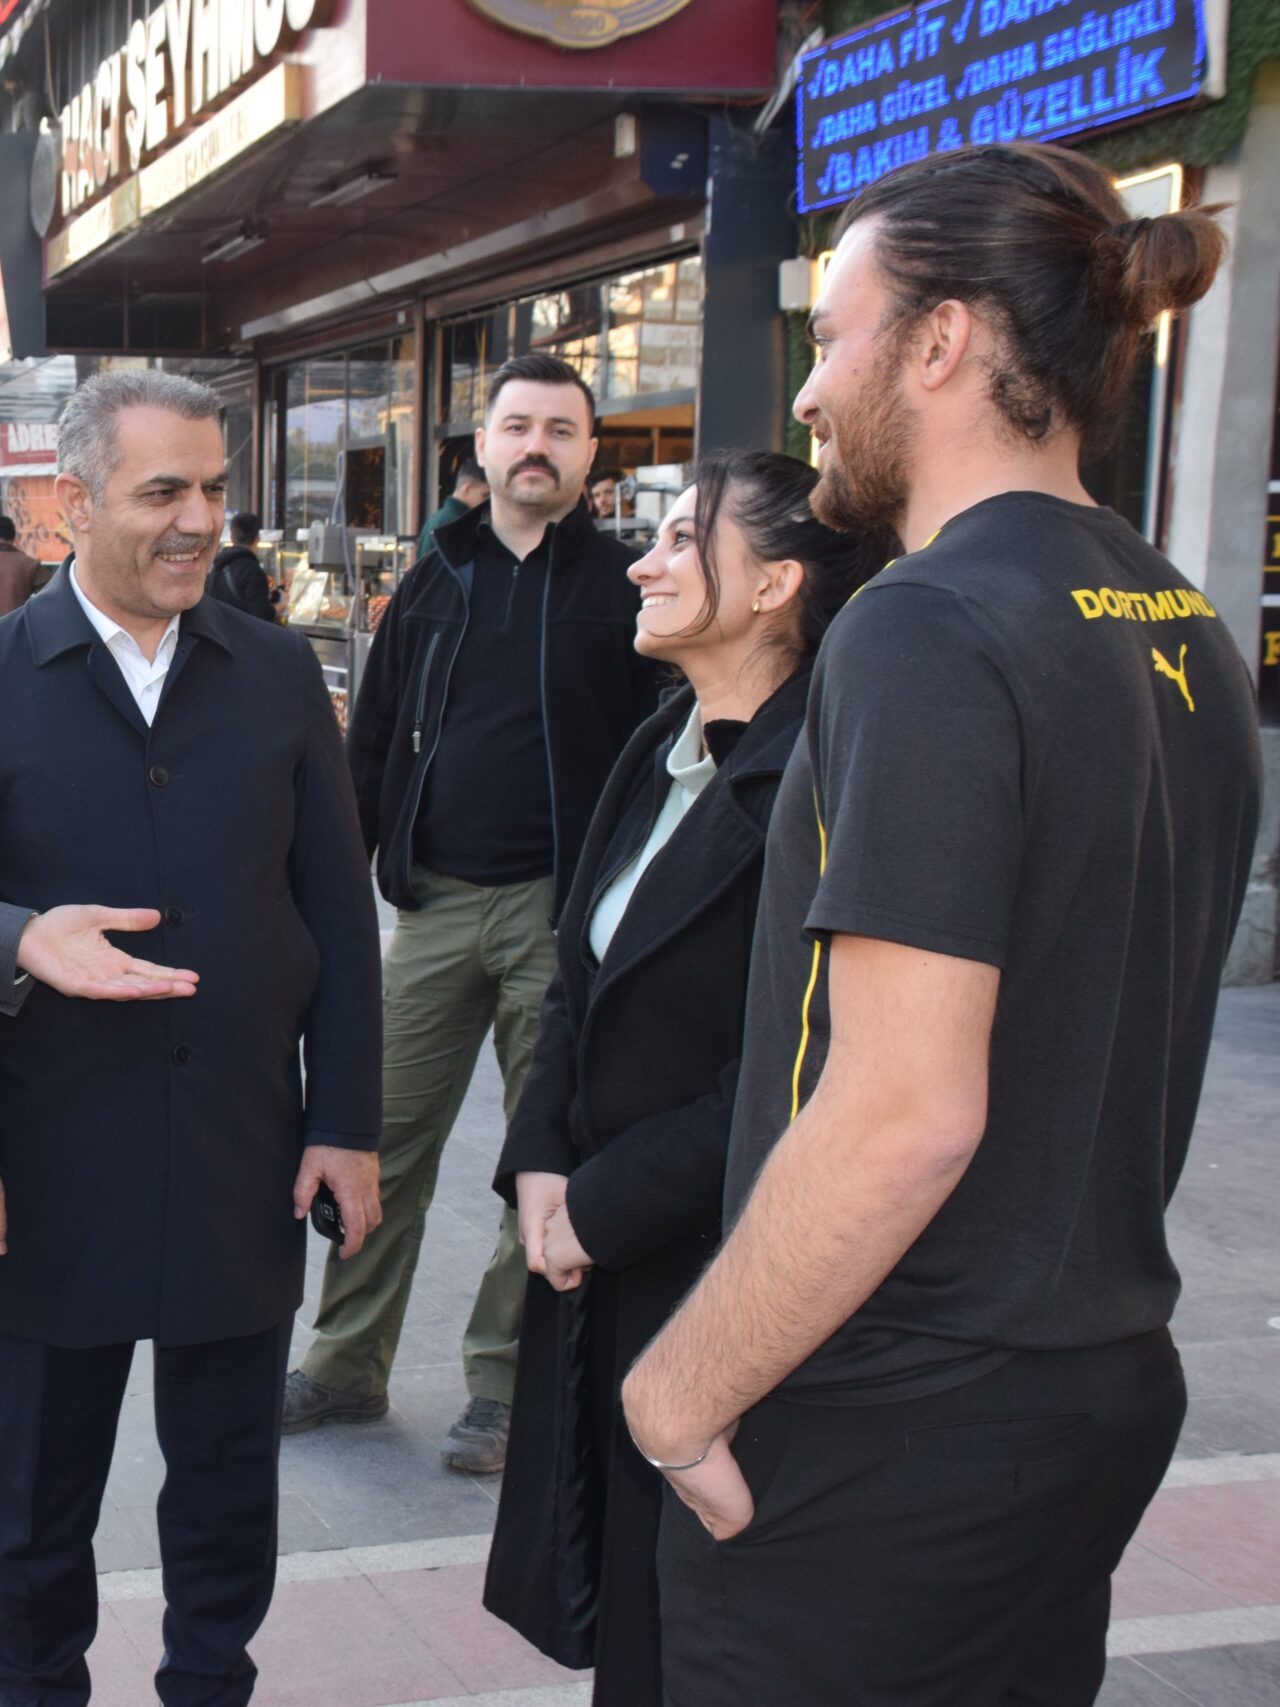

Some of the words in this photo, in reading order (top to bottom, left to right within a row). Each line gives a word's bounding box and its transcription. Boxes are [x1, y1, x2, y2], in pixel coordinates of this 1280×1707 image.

[822, 100, 878, 146] DAHA
[880, 75, 950, 126] GÜZEL
[970, 41, 1038, 96] DAHA
[1042, 0, 1176, 71] SAĞLIKLI
[823, 37, 896, 97] DAHA
[899, 15, 946, 68] FİT
[834, 125, 929, 194] BAKIM
[936, 117, 963, 153] &
[970, 46, 1166, 146] GÜZELLİK
[61, 50, 121, 217] HACI
[1071, 587, 1217, 622] DORTMUND
